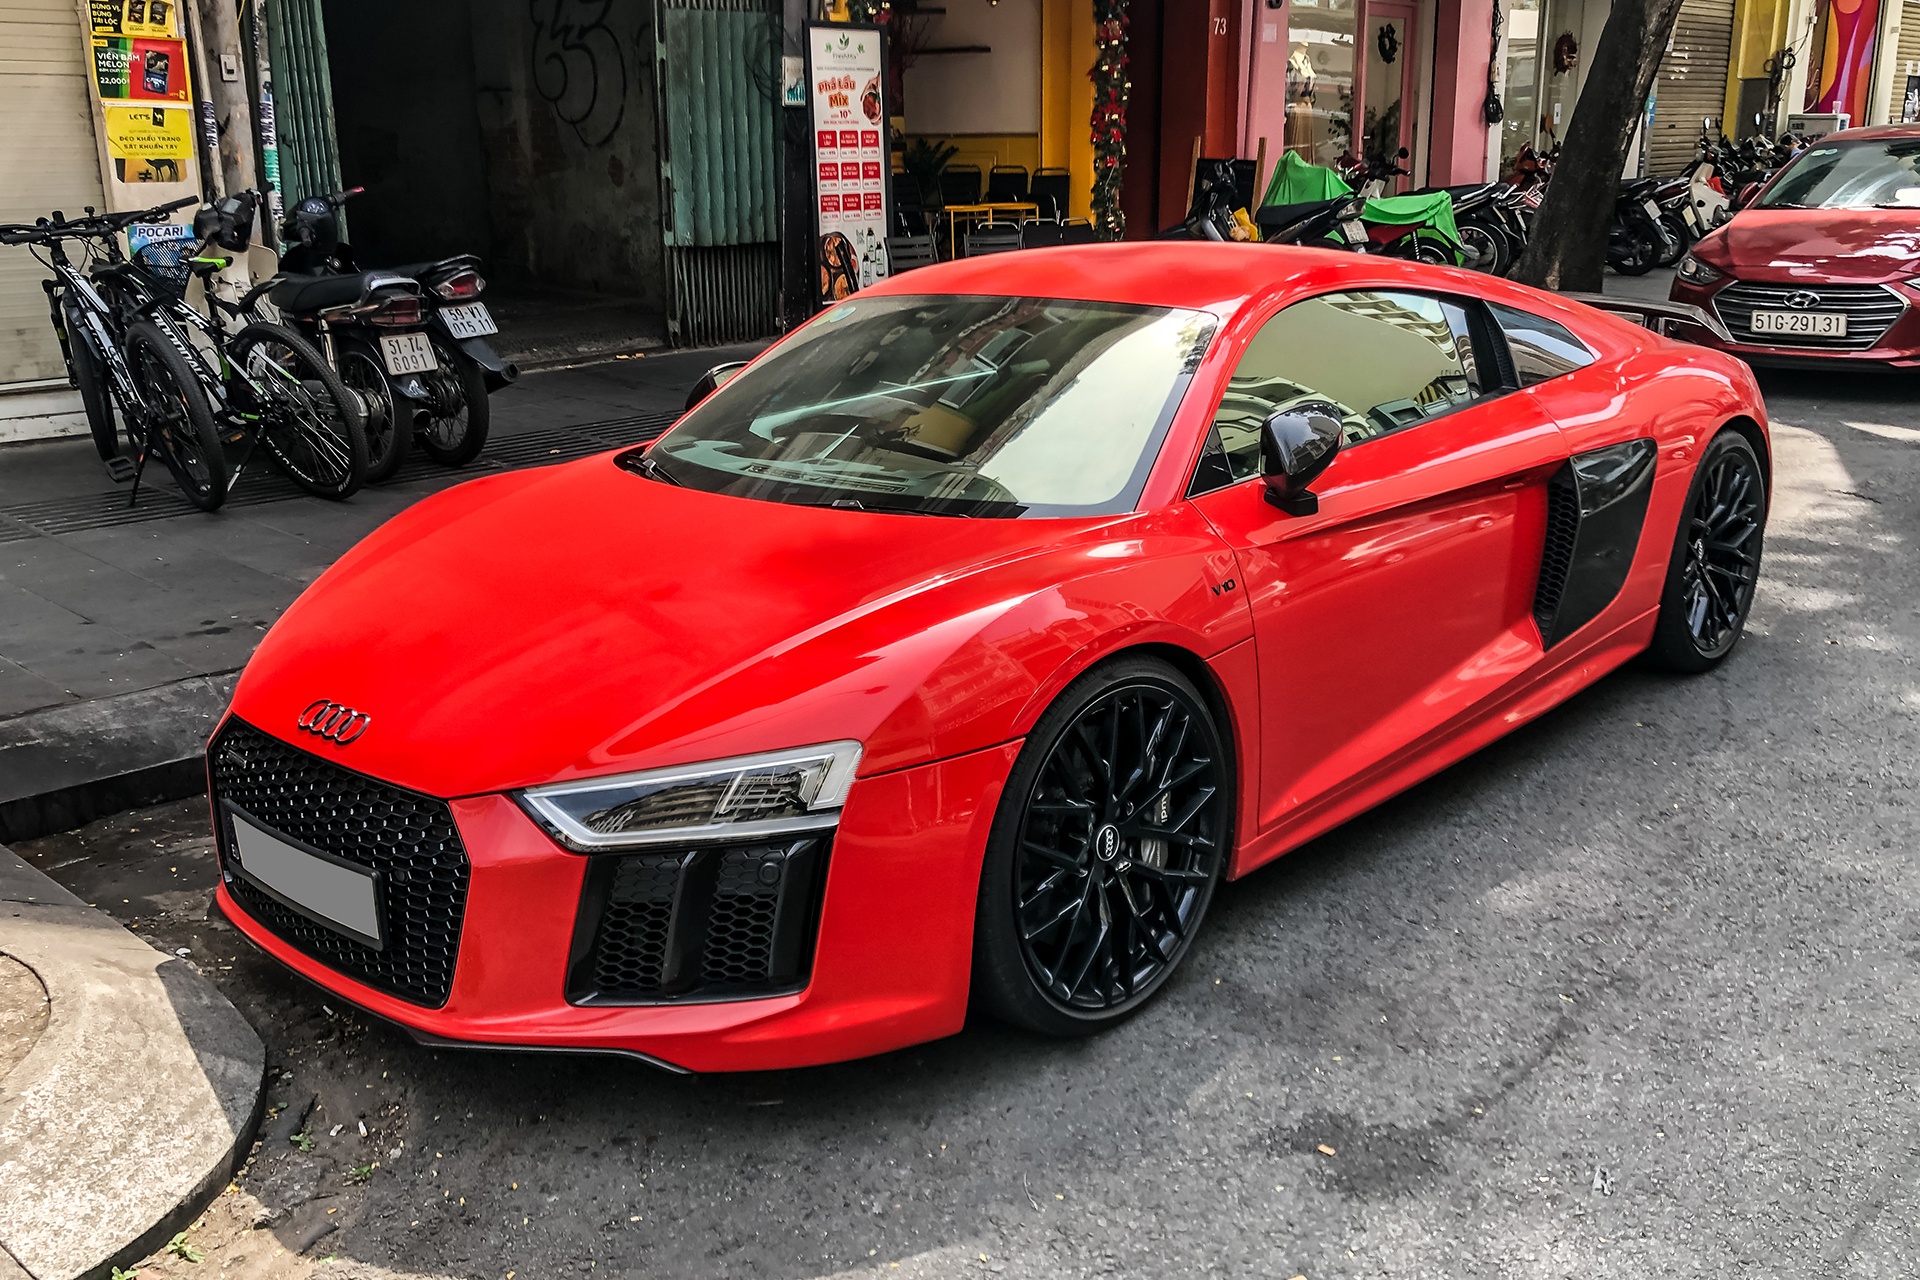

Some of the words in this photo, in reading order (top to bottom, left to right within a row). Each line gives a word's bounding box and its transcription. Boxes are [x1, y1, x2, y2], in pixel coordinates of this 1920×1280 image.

[1213, 17, 1227, 35] 73
[98, 60, 130, 68] MELON
[829, 92, 849, 108] Mix
[138, 226, 183, 237] POCARI
[448, 306, 483, 321] 59-V1
[452, 319, 493, 335] 015.11
[1755, 314, 1839, 332] 51G-291.31
[393, 354, 428, 372] 6091
[1211, 579, 1236, 596] V10
